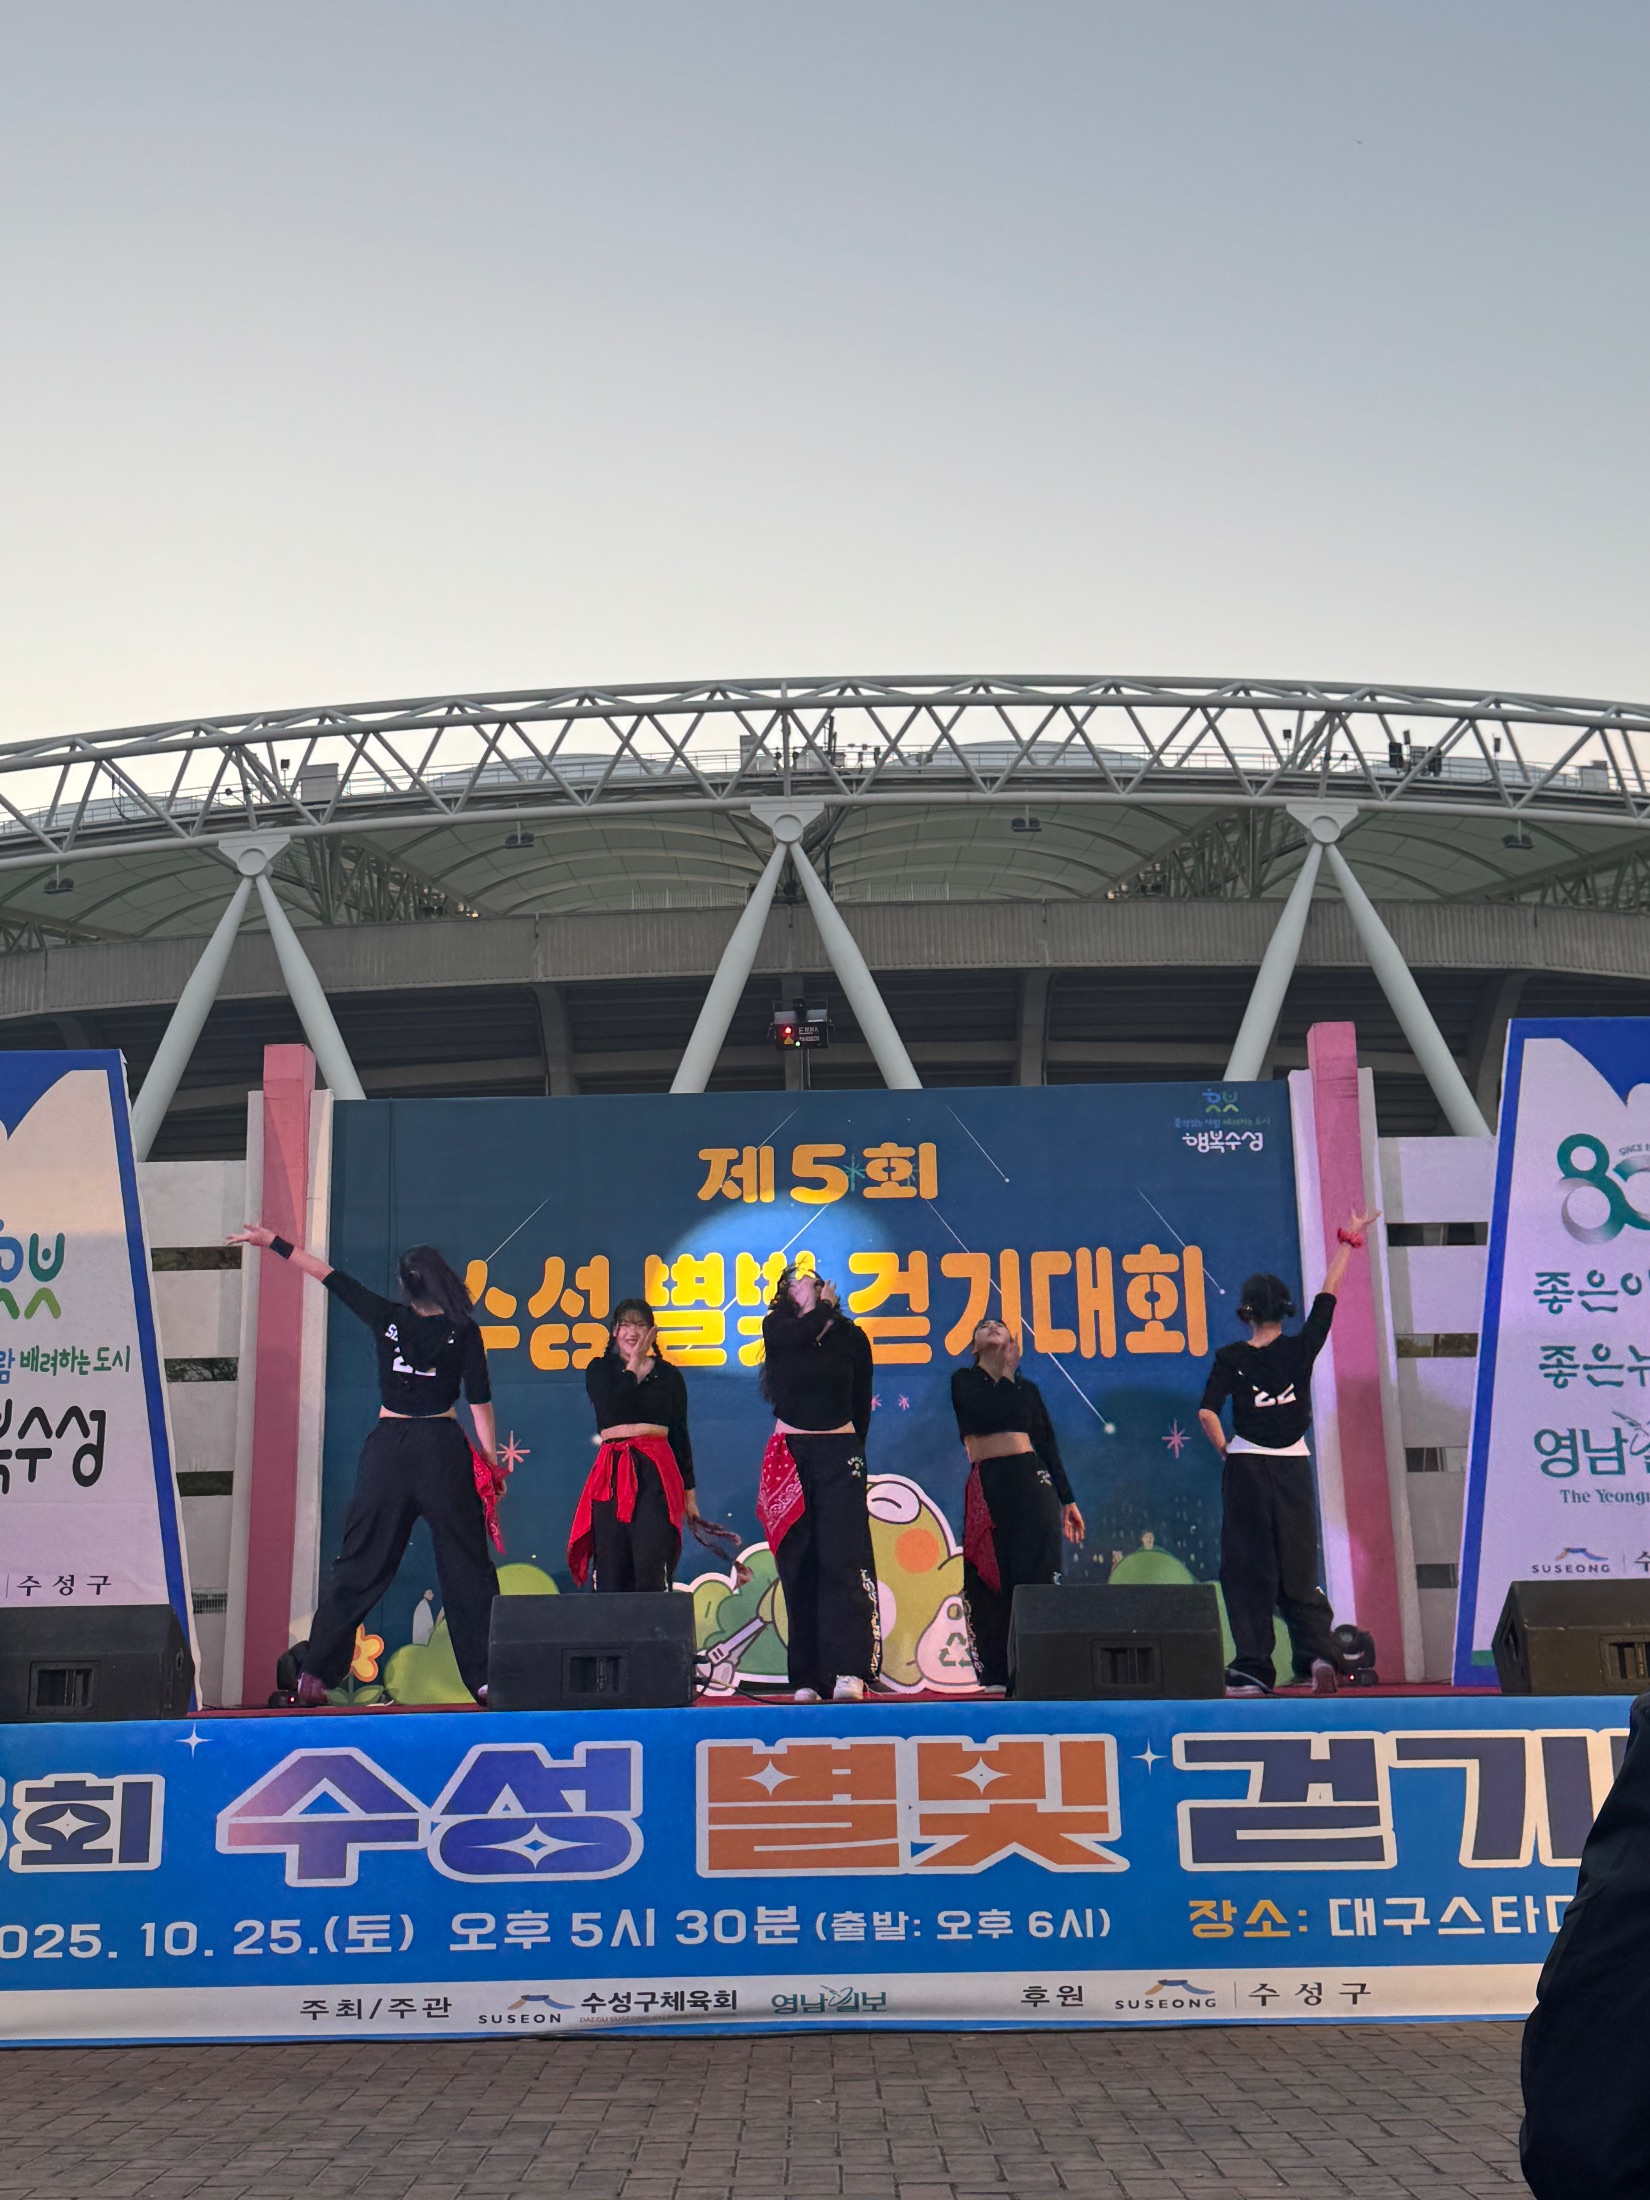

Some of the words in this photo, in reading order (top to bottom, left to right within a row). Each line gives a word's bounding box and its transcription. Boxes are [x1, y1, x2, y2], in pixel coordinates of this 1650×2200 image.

[1182, 1130, 1264, 1153] 행복수성
[698, 1142, 938, 1204] 제5회
[20, 1345, 91, 1376] 배려하는
[93, 1345, 130, 1372] 도시
[1560, 1489, 1591, 1503] The
[1531, 1564, 1610, 1574] SUSEONG
[0, 1773, 165, 1873] 회
[216, 1742, 643, 1887] 수성
[696, 1736, 1130, 1878] 별빛
[1172, 1728, 1631, 1871] 걷기
[1189, 1898, 1307, 1939] 장소:
[1329, 1894, 1573, 1938] 대구스타
[141, 1920, 214, 1957] 10.
[450, 1909, 551, 1952] 오후
[571, 1908, 656, 1948] 5시
[676, 1905, 800, 1947] 30분
[815, 1911, 921, 1942] (출발:
[937, 1909, 1013, 1940] 오후
[1028, 1907, 1112, 1940] 6시)
[300, 1996, 452, 2021] 주최/주관
[580, 1989, 737, 2014] 수성구체육회
[1115, 1999, 1216, 2010] SUSEONG
[478, 2014, 561, 2024] SUSEON
